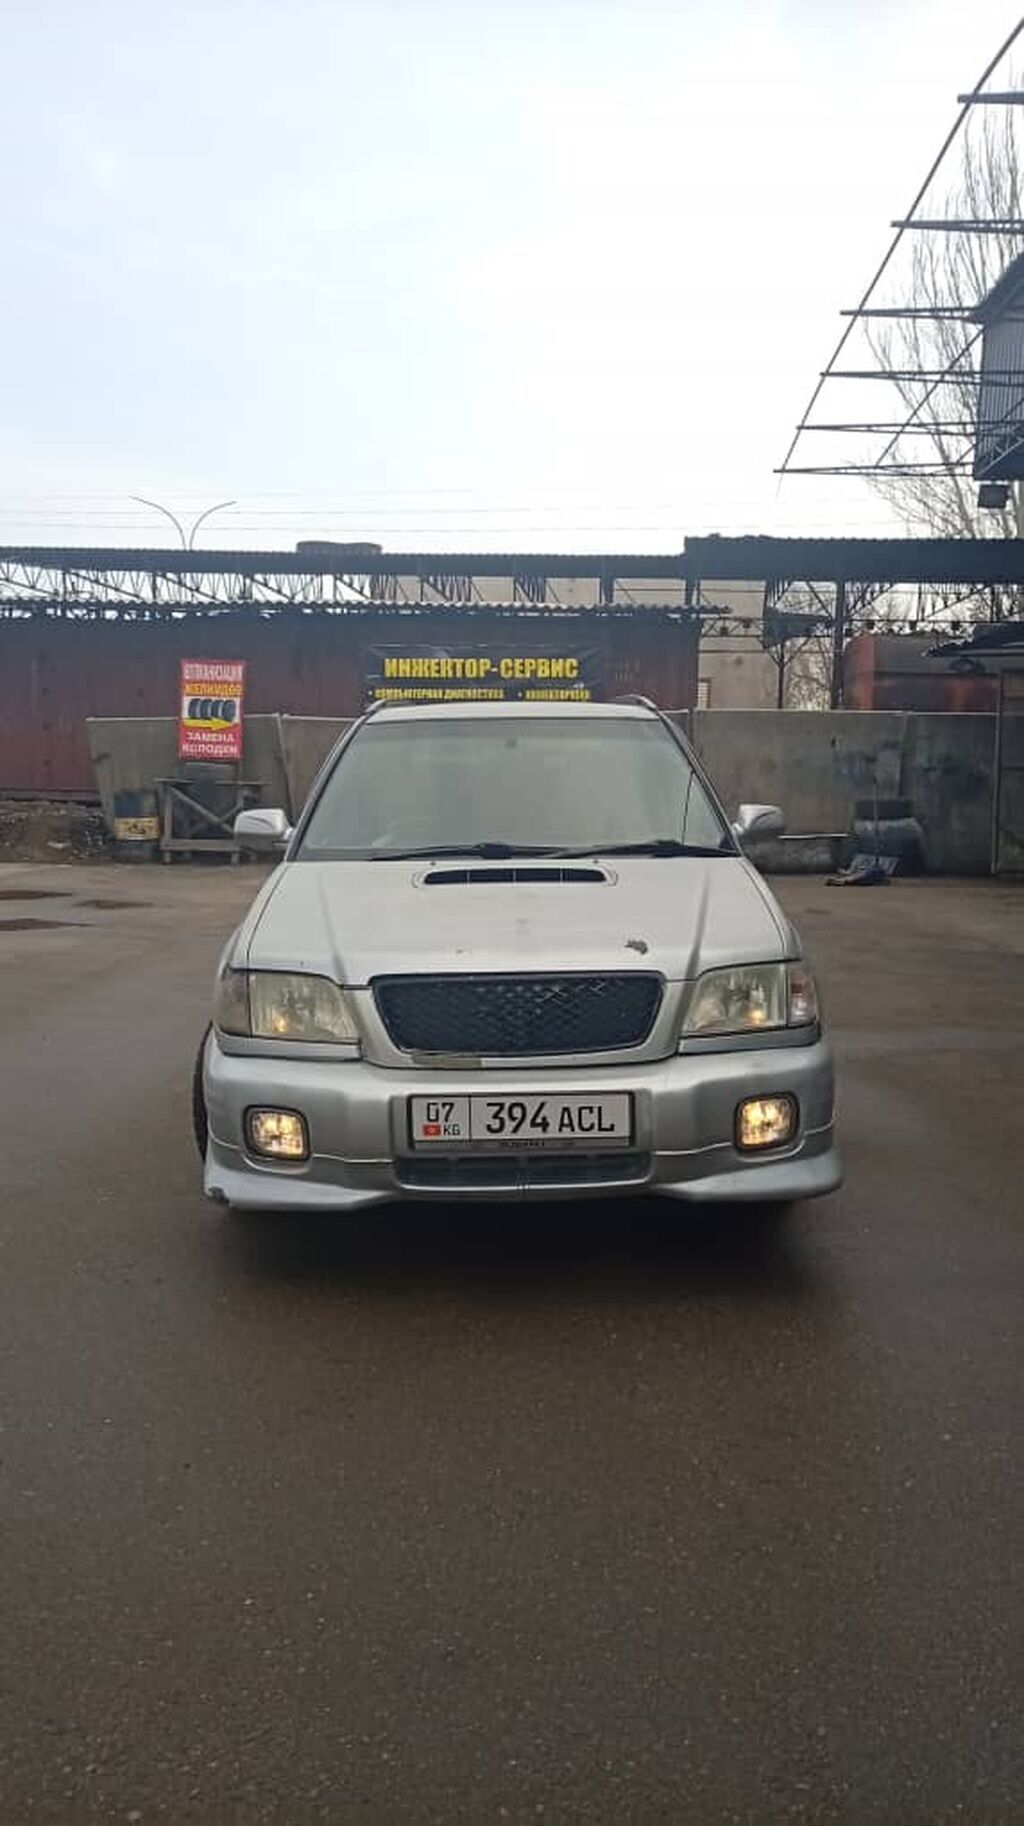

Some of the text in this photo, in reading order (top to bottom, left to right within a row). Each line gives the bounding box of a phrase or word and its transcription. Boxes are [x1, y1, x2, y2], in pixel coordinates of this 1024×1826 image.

[384, 658, 579, 679] ИНЖЕКТОР-СЕРВИС
[186, 731, 234, 742] ЗАМЕНА
[426, 1103, 455, 1123] 07
[486, 1102, 615, 1134] 394 ACL
[443, 1124, 461, 1136] KG
